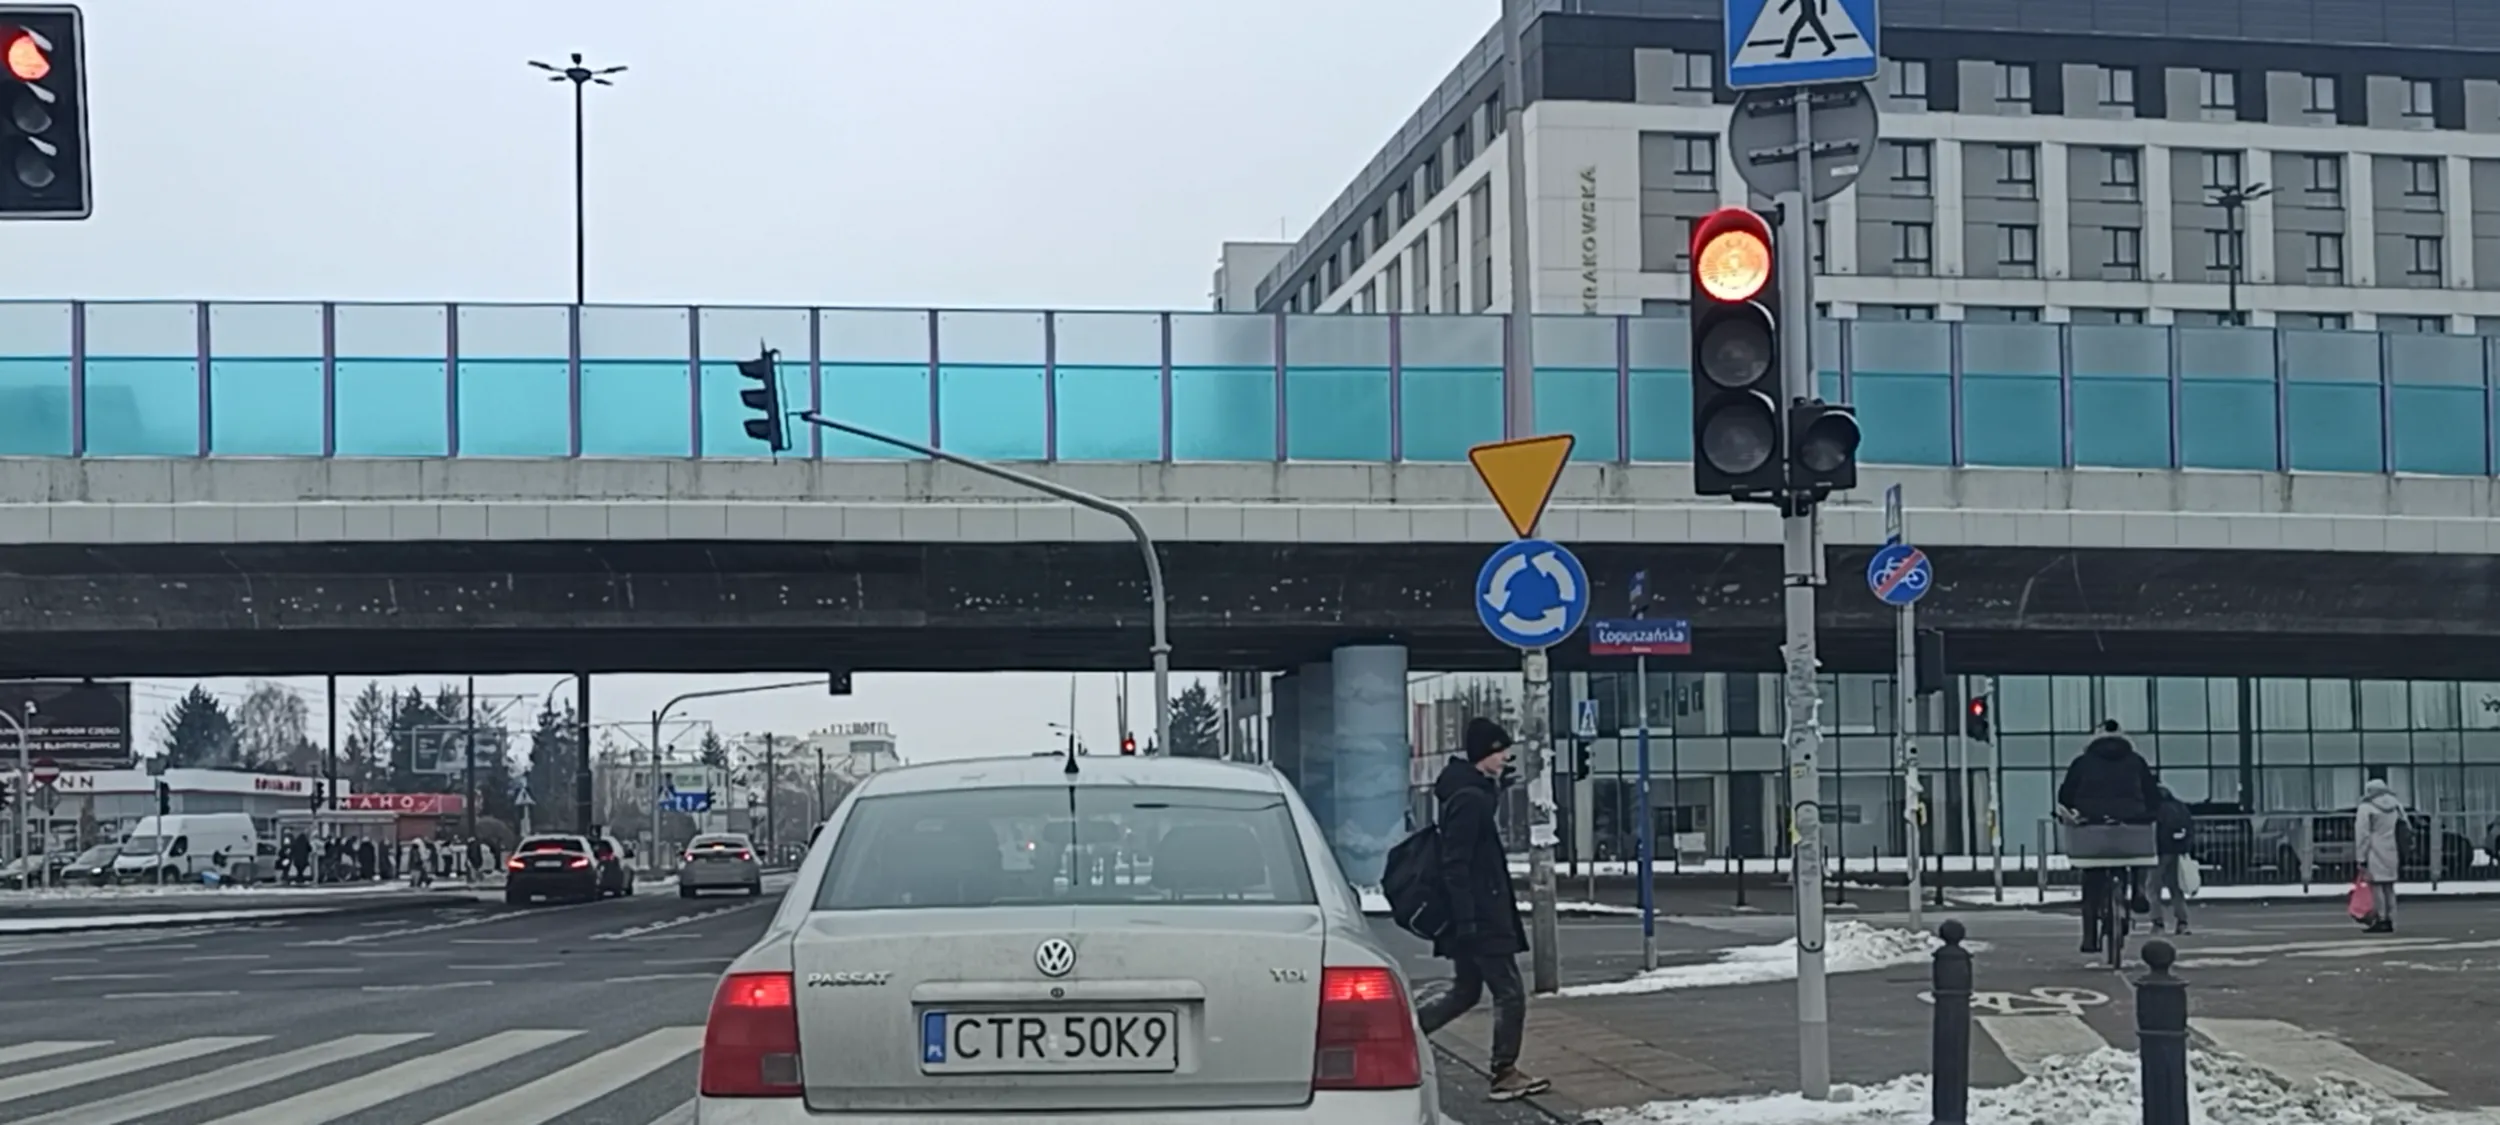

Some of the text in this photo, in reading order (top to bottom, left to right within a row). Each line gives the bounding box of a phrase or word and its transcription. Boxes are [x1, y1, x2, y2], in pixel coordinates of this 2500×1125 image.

[1580, 165, 1597, 316] KRAKOWSKA
[1599, 627, 1685, 646] Łopuszańska
[807, 970, 891, 987] PASSAT
[1269, 967, 1308, 983] TDI
[953, 1016, 1167, 1059] CTR 50K9
